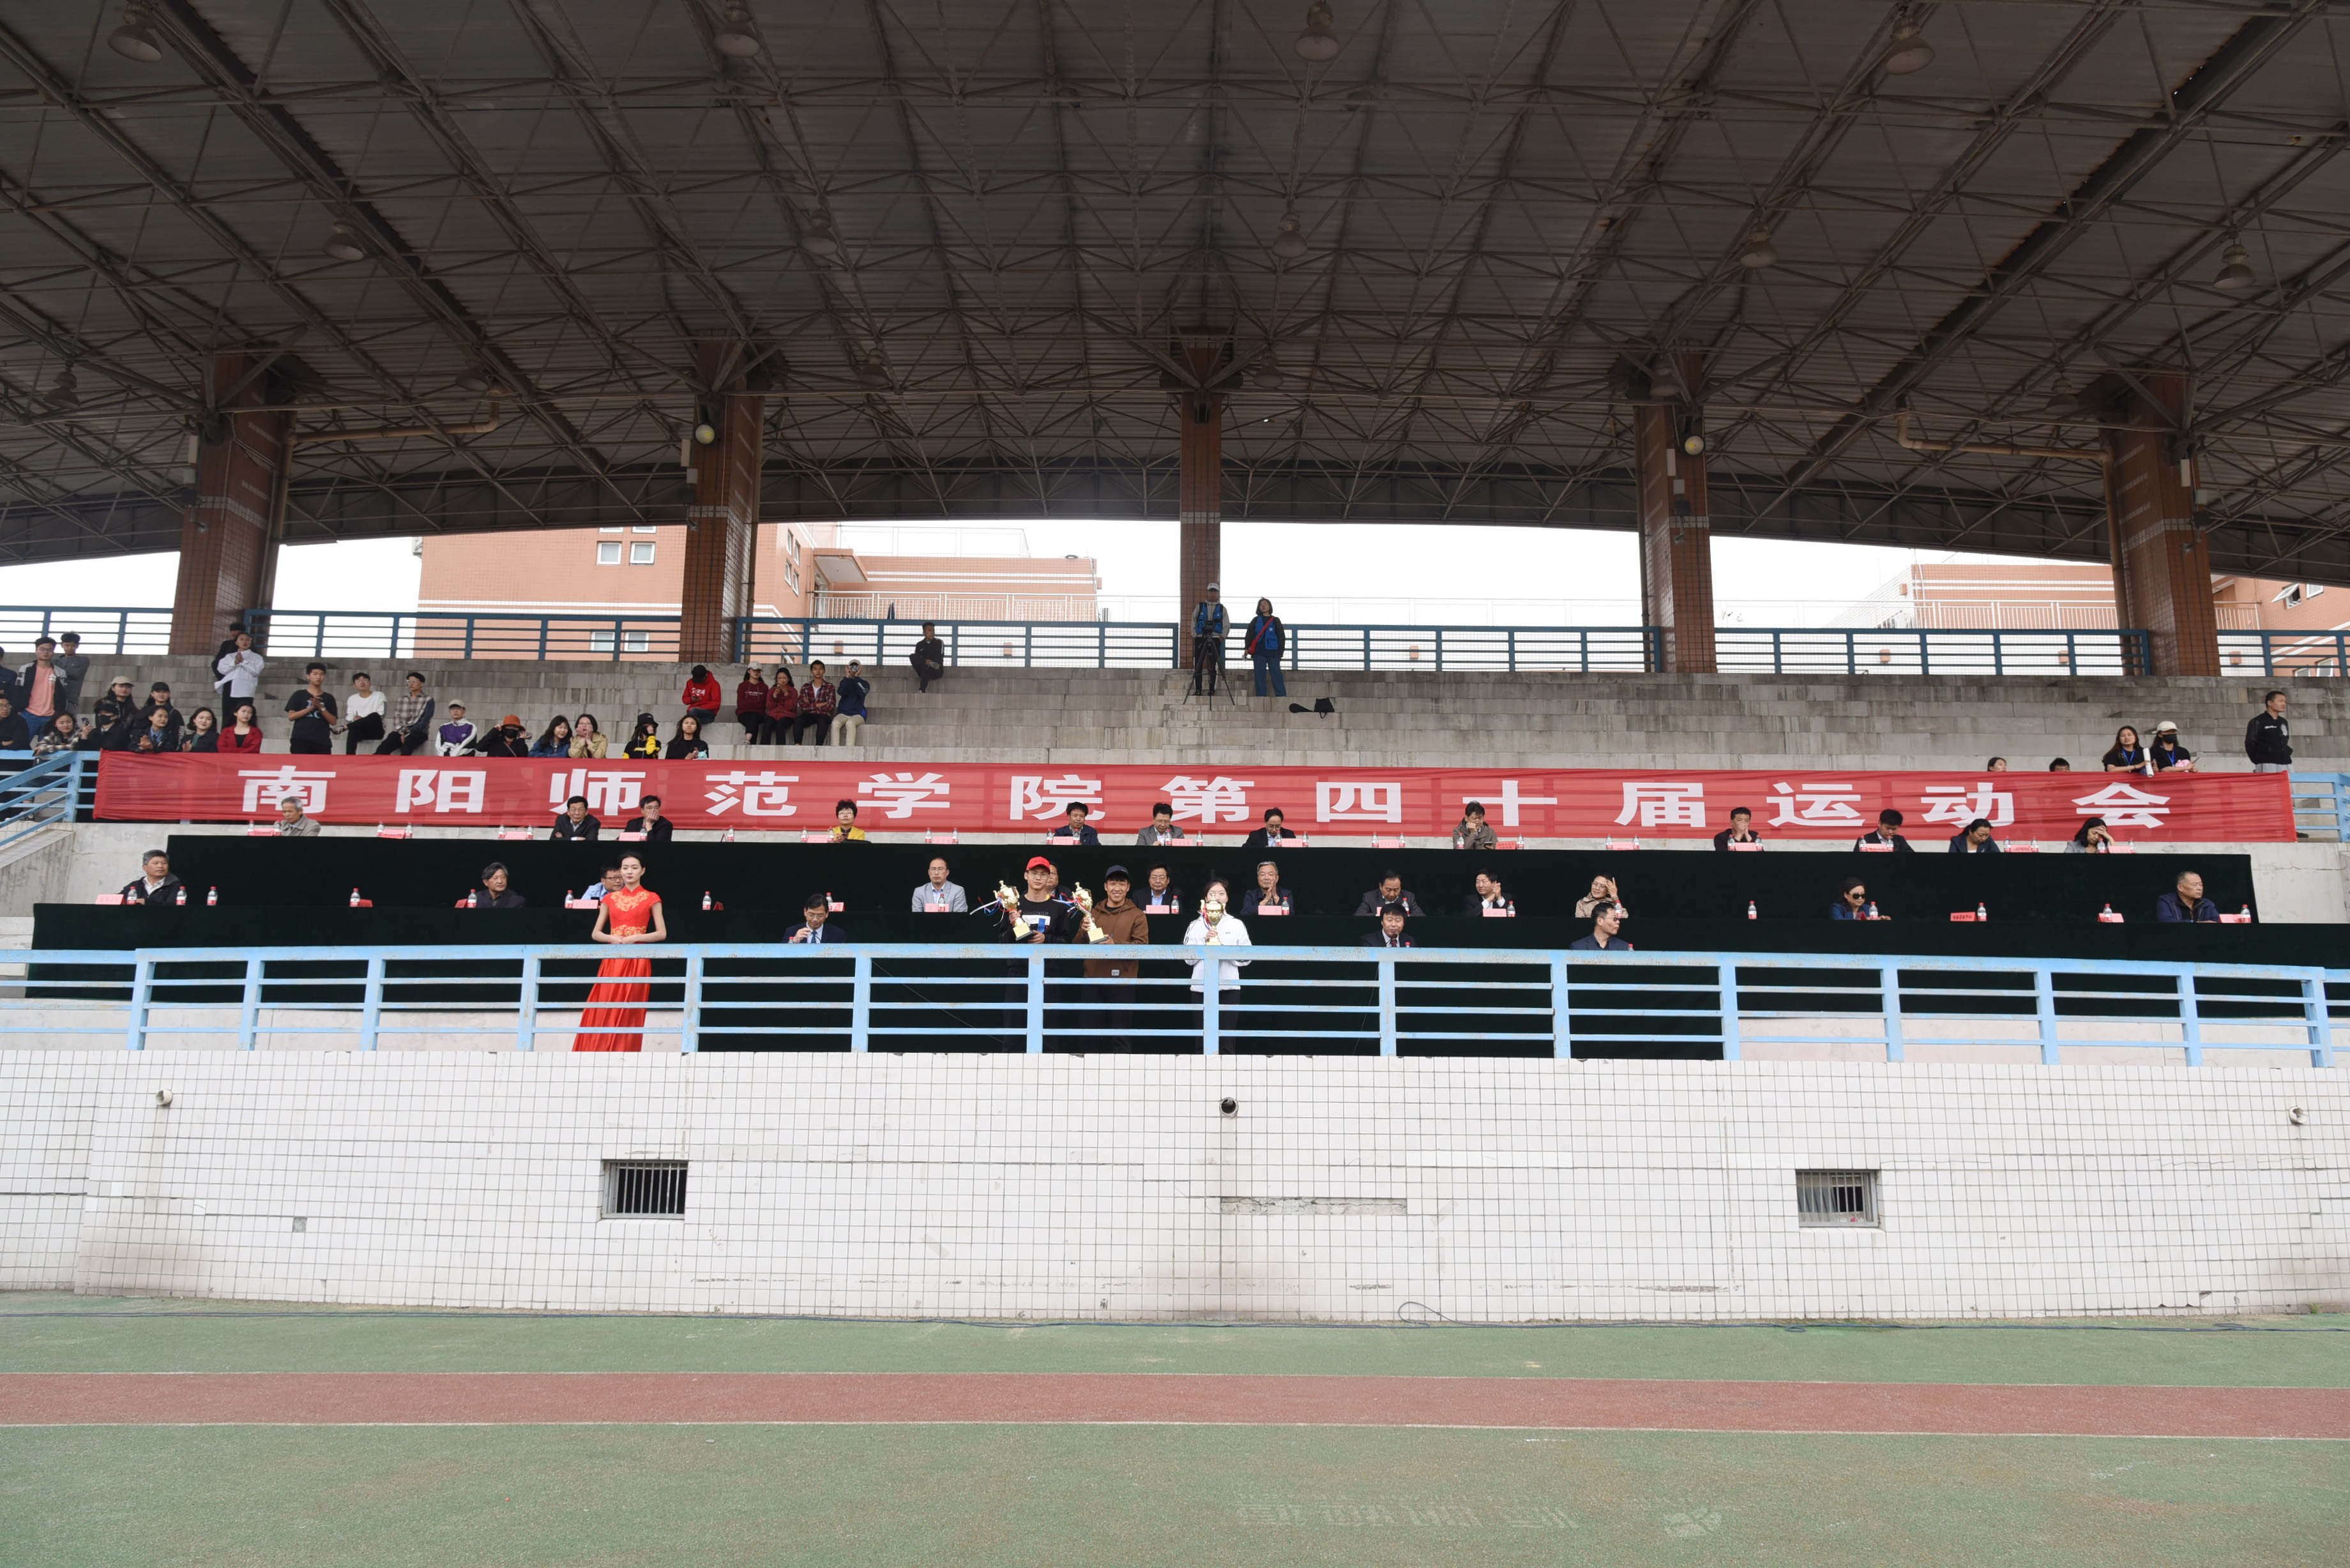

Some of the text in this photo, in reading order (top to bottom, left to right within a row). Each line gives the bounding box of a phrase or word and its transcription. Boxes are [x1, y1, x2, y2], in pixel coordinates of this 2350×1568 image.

[238, 765, 2171, 829] 南阳师范学院第四十届运动会
